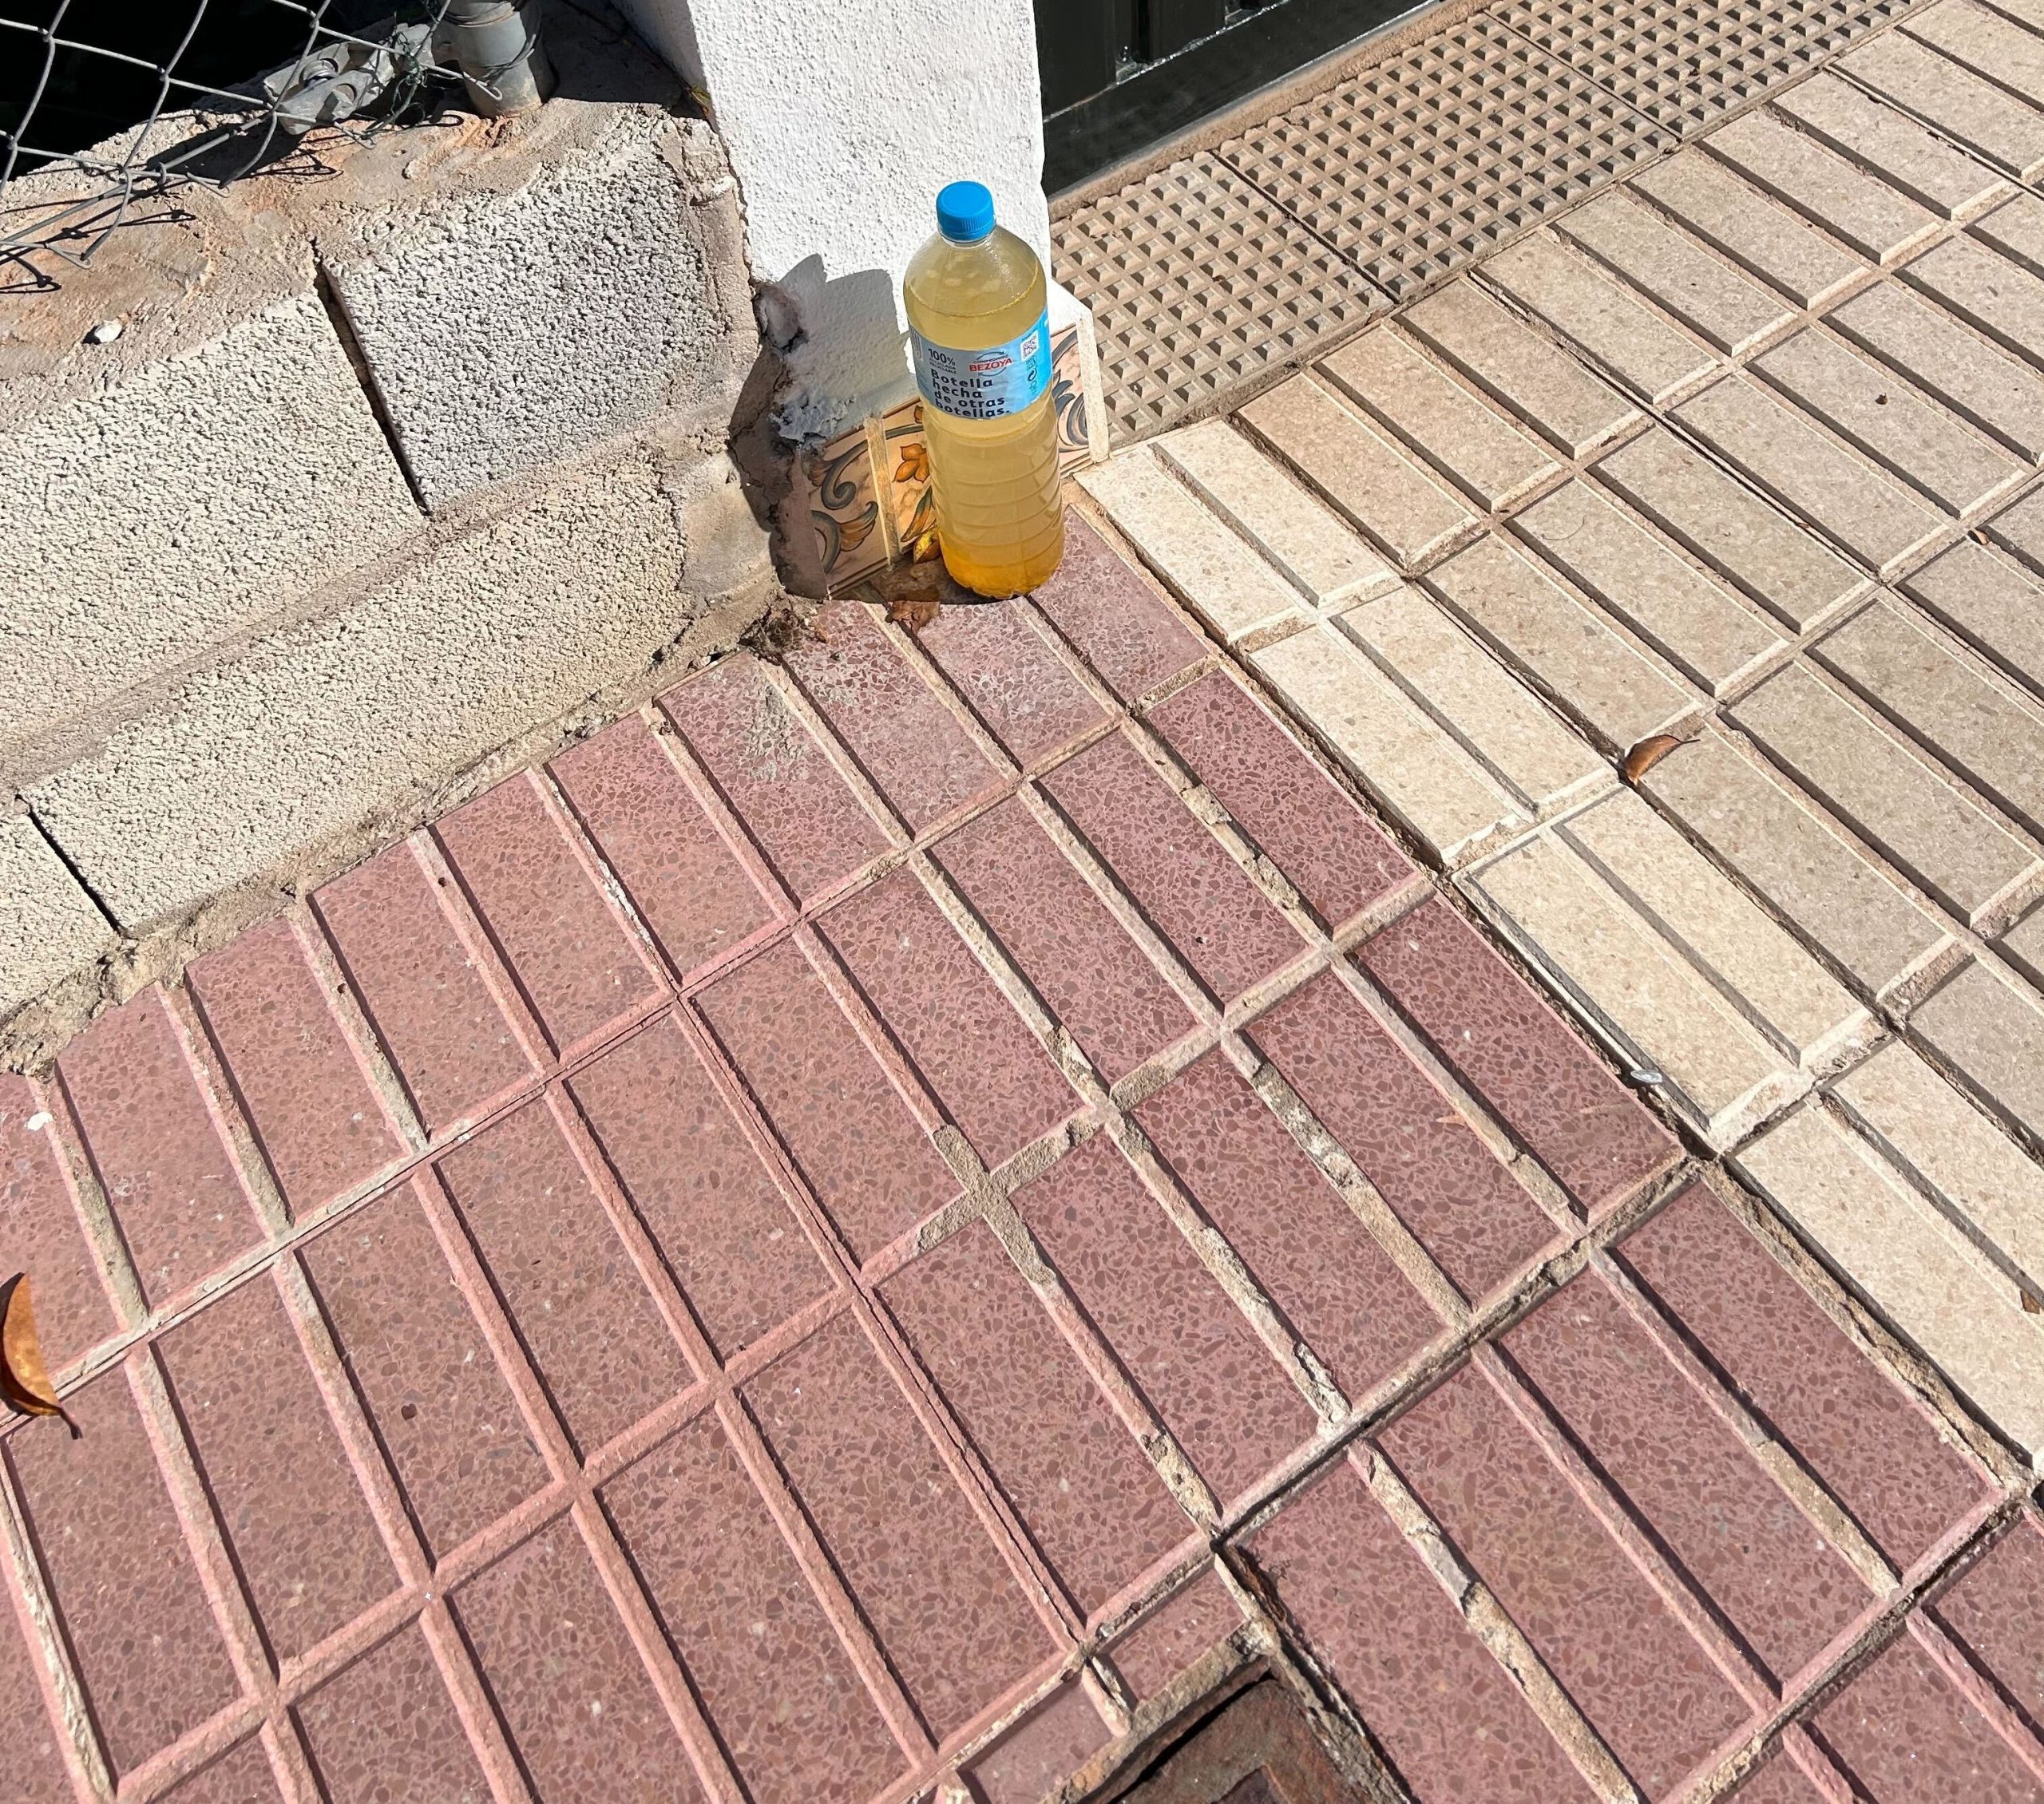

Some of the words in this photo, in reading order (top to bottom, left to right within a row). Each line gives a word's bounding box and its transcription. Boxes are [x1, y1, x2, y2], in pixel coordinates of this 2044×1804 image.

[928, 348, 956, 366] 100%
[969, 358, 1012, 372] BEZOYA
[931, 368, 993, 388] Botella
[933, 378, 982, 398] hecha
[934, 390, 952, 404] de
[958, 397, 1005, 408] otras
[935, 398, 1009, 417] botellas.
